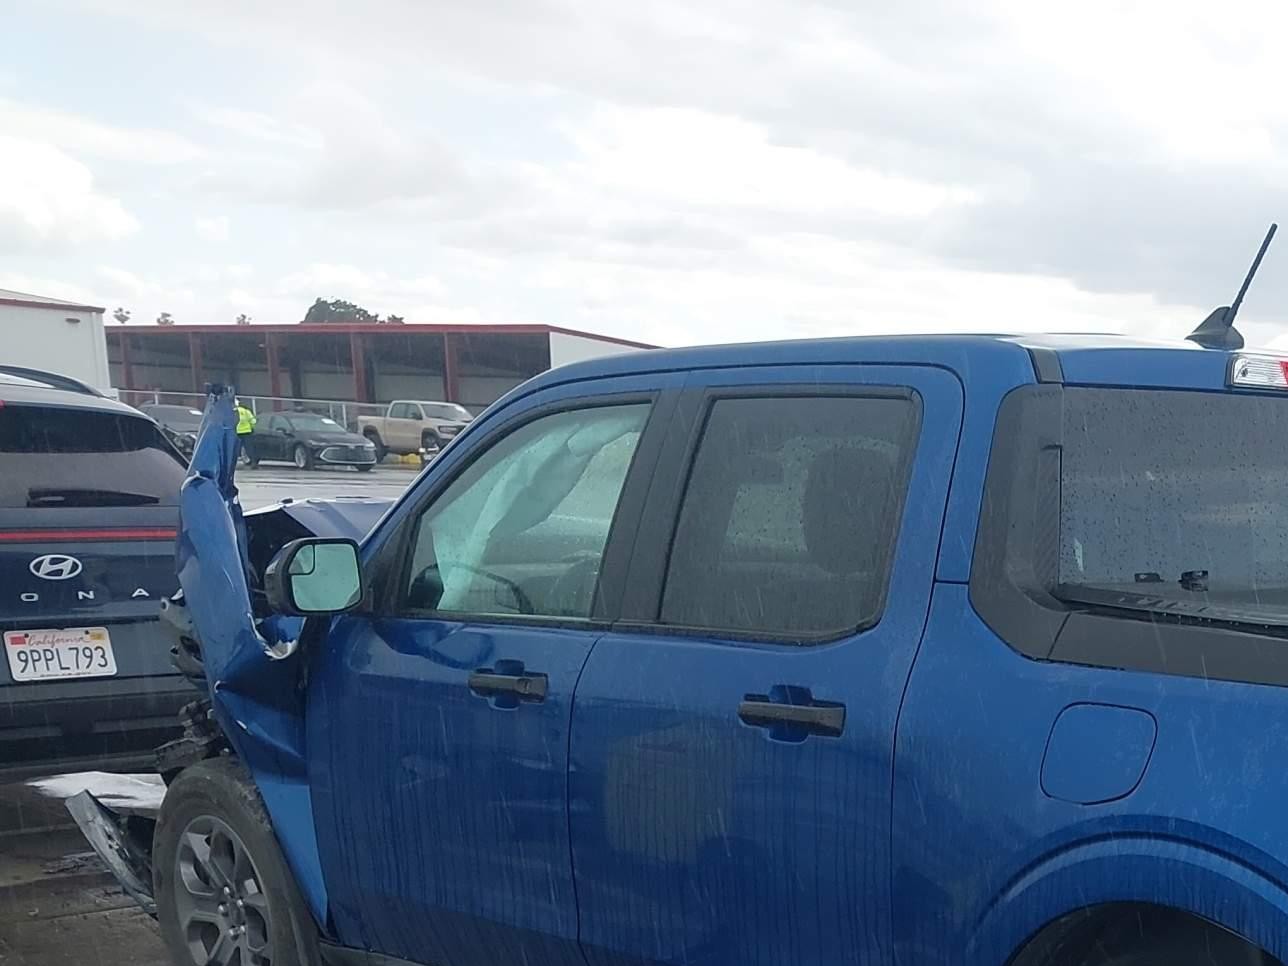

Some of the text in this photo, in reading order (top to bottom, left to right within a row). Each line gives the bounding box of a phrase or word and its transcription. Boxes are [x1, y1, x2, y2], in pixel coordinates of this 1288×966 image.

[20, 587, 150, 602] ONA
[28, 634, 90, 648] California
[17, 646, 108, 673] 9PPL793
